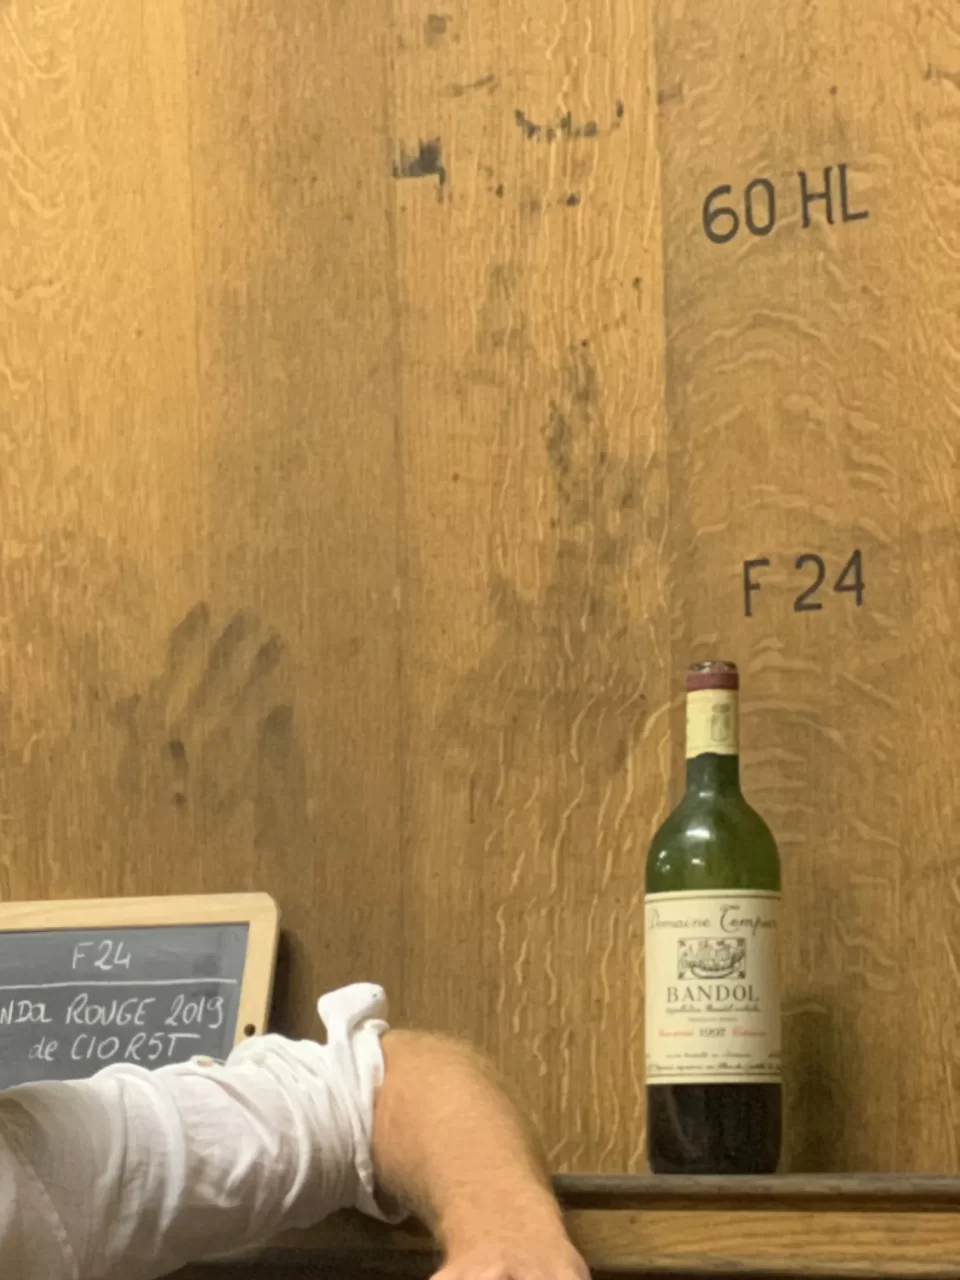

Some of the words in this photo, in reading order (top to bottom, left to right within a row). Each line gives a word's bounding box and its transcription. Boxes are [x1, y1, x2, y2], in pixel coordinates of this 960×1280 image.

[702, 178, 776, 243] 60
[798, 163, 869, 228] HL
[743, 558, 770, 616] F
[794, 549, 865, 611] 24
[65, 993, 156, 1026] ROUGE
[164, 993, 224, 1029] 2019
[667, 983, 760, 1003] BANDOL
